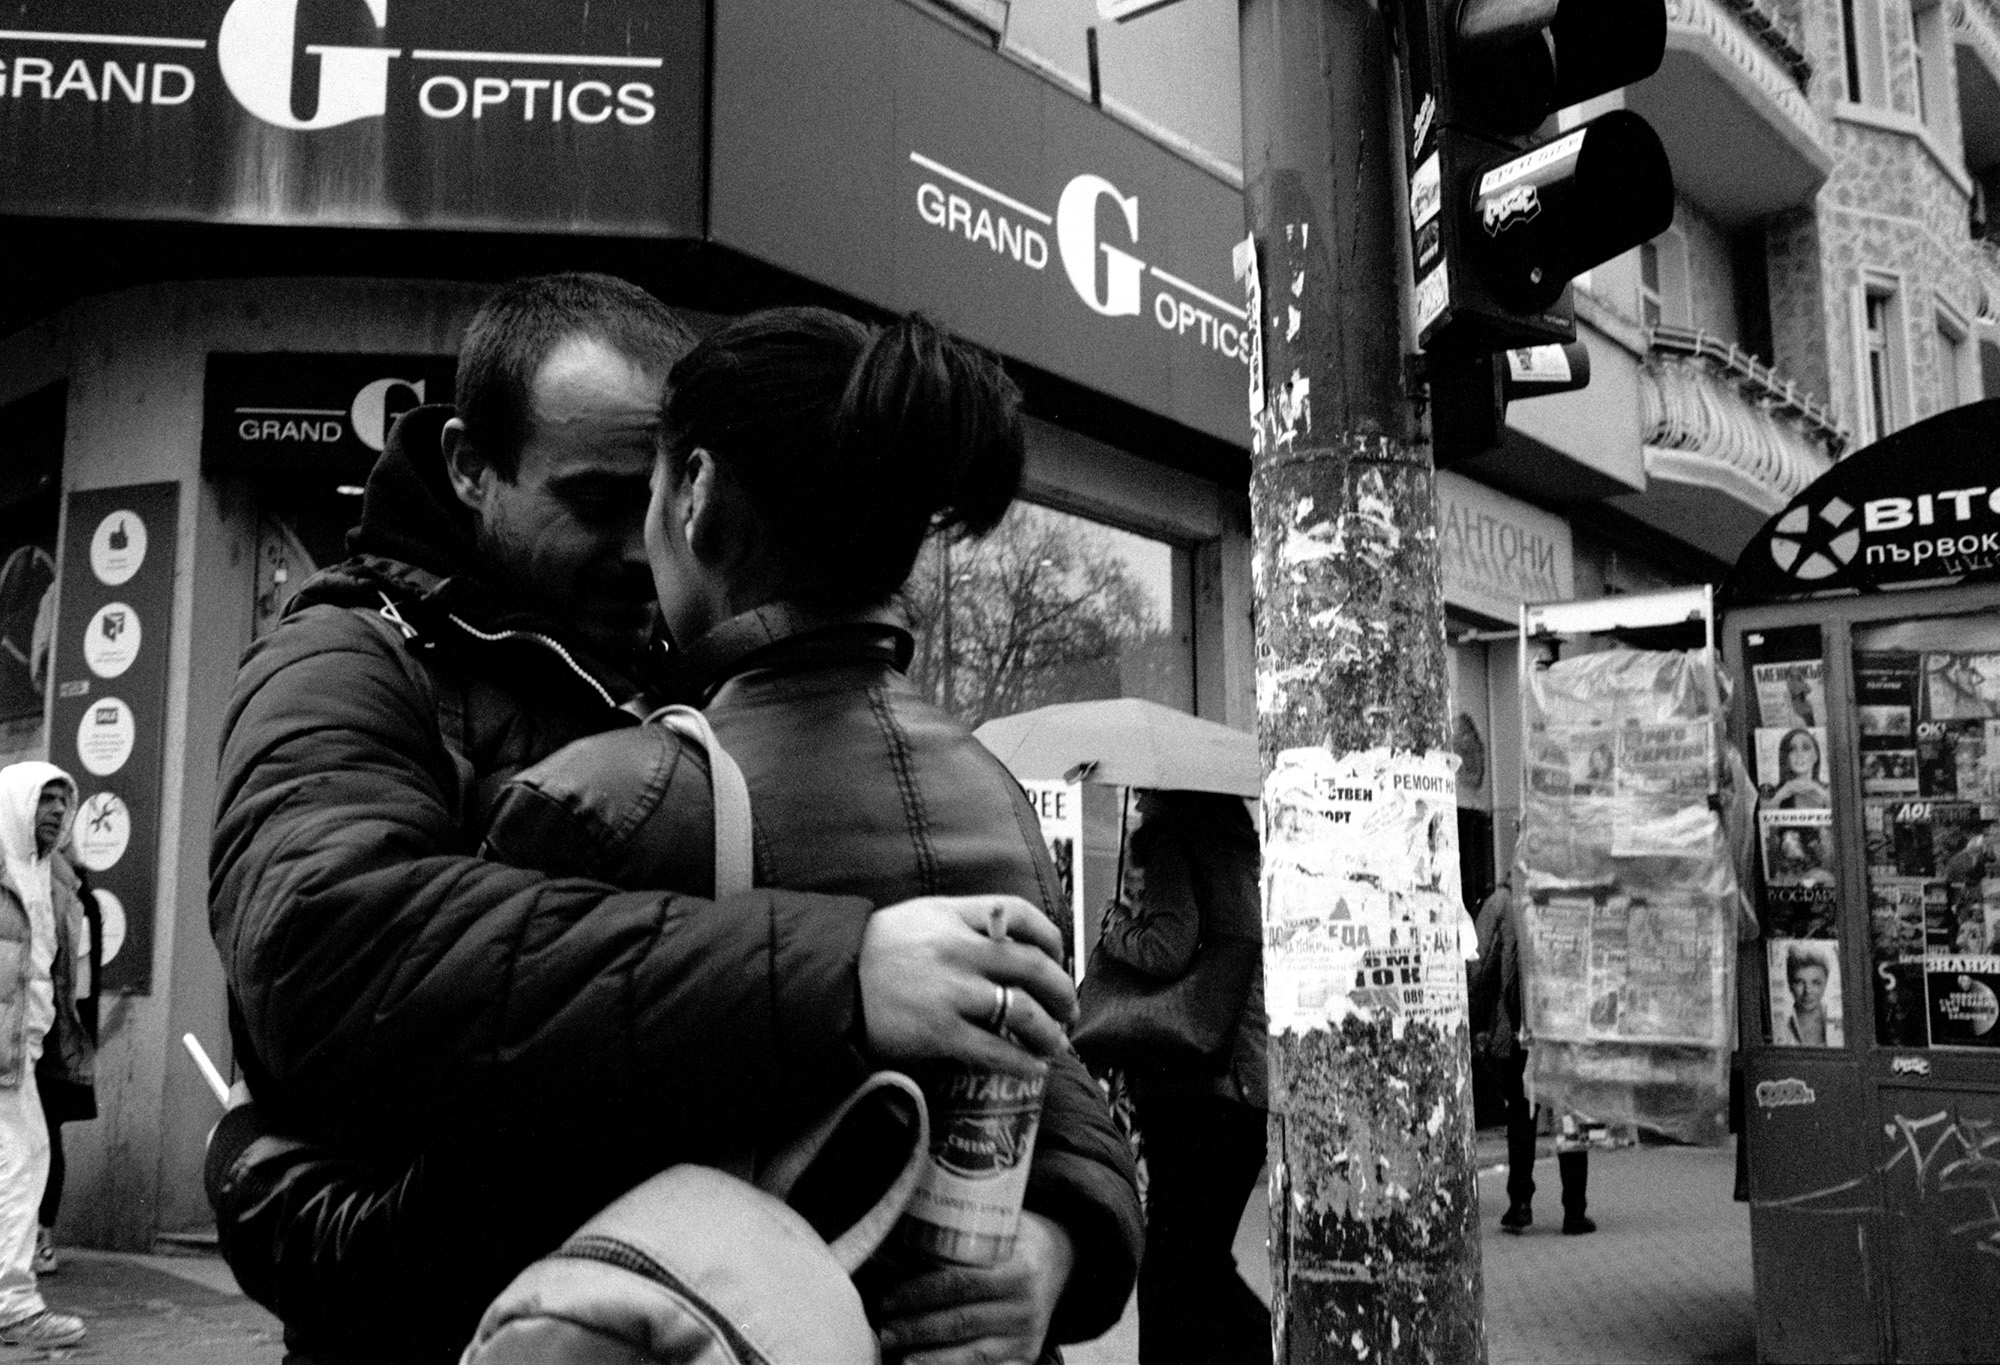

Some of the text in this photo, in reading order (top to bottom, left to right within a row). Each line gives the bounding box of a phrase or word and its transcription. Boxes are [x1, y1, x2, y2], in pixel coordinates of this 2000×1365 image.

[218, 0, 401, 130] G
[418, 76, 656, 125] OPTICS
[916, 183, 1048, 270] GRAND
[1057, 174, 1145, 316] G
[238, 419, 342, 442] GRAND
[1441, 501, 1555, 579] АНТОНИ
[1866, 532, 2000, 566] първок
[1393, 774, 1443, 793] РЕМОНТ
[1319, 810, 1352, 824] ОРТ
